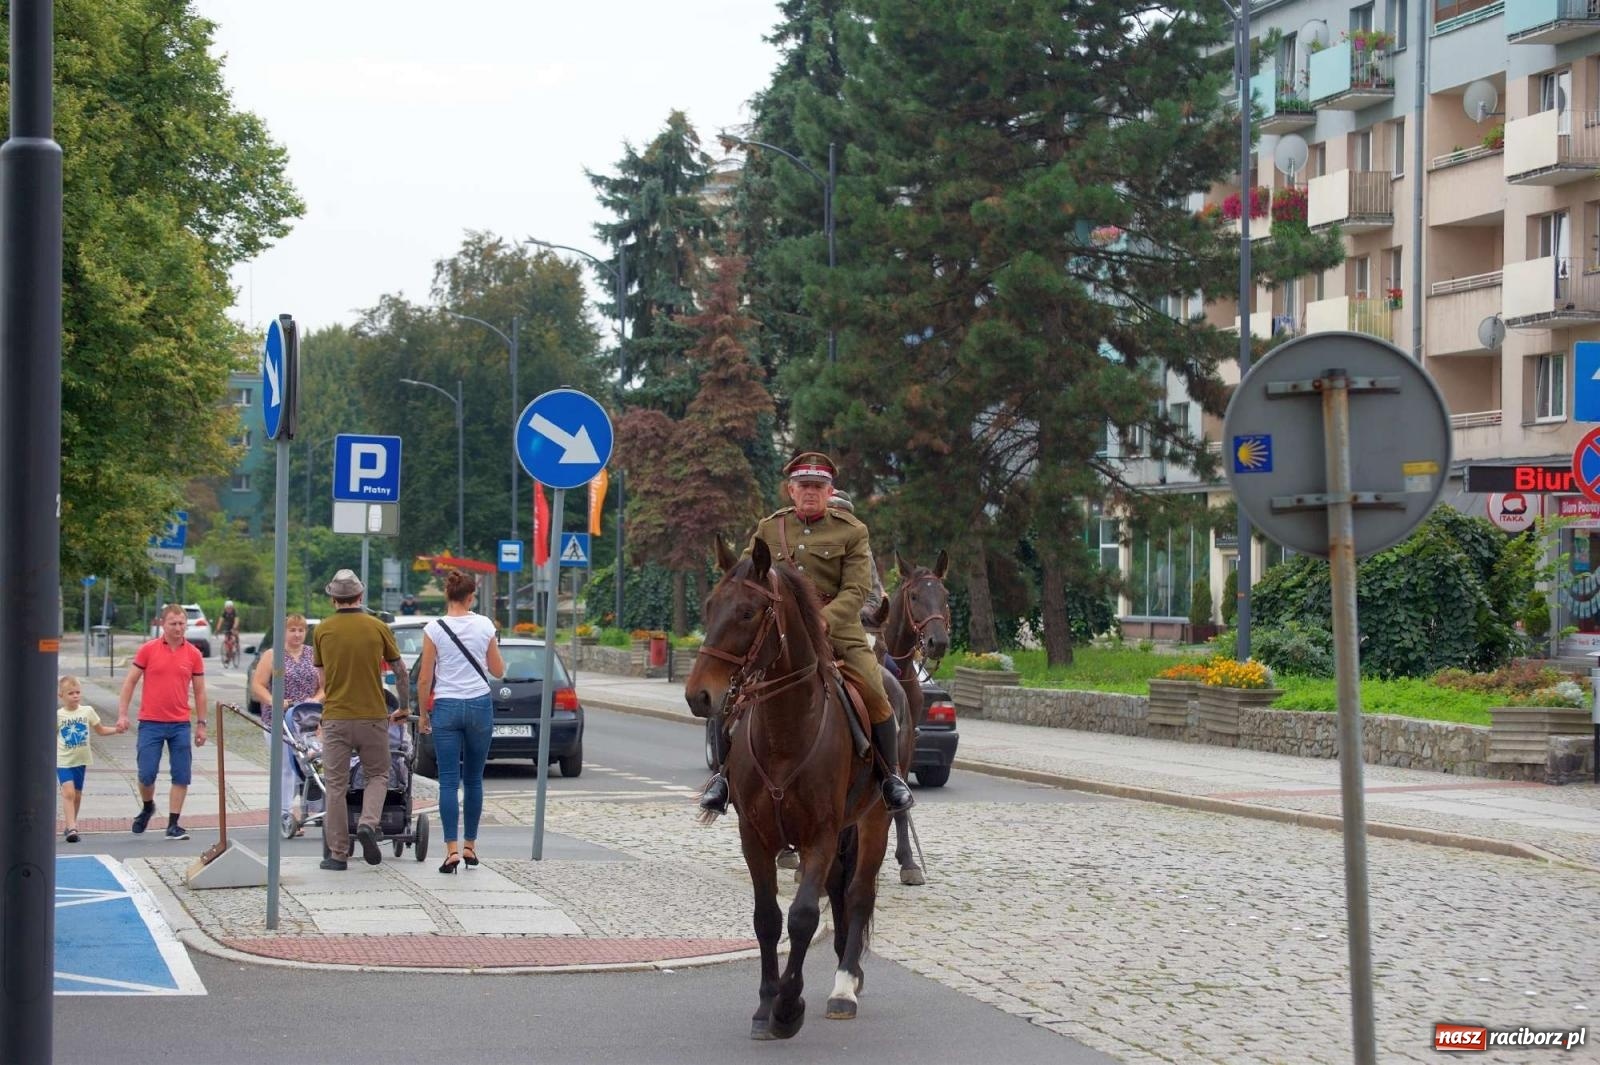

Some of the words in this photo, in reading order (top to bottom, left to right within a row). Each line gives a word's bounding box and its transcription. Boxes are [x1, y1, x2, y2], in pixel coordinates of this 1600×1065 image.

[349, 443, 387, 493] P
[363, 485, 391, 496] Płatny
[1500, 514, 1525, 523] ITAKA
